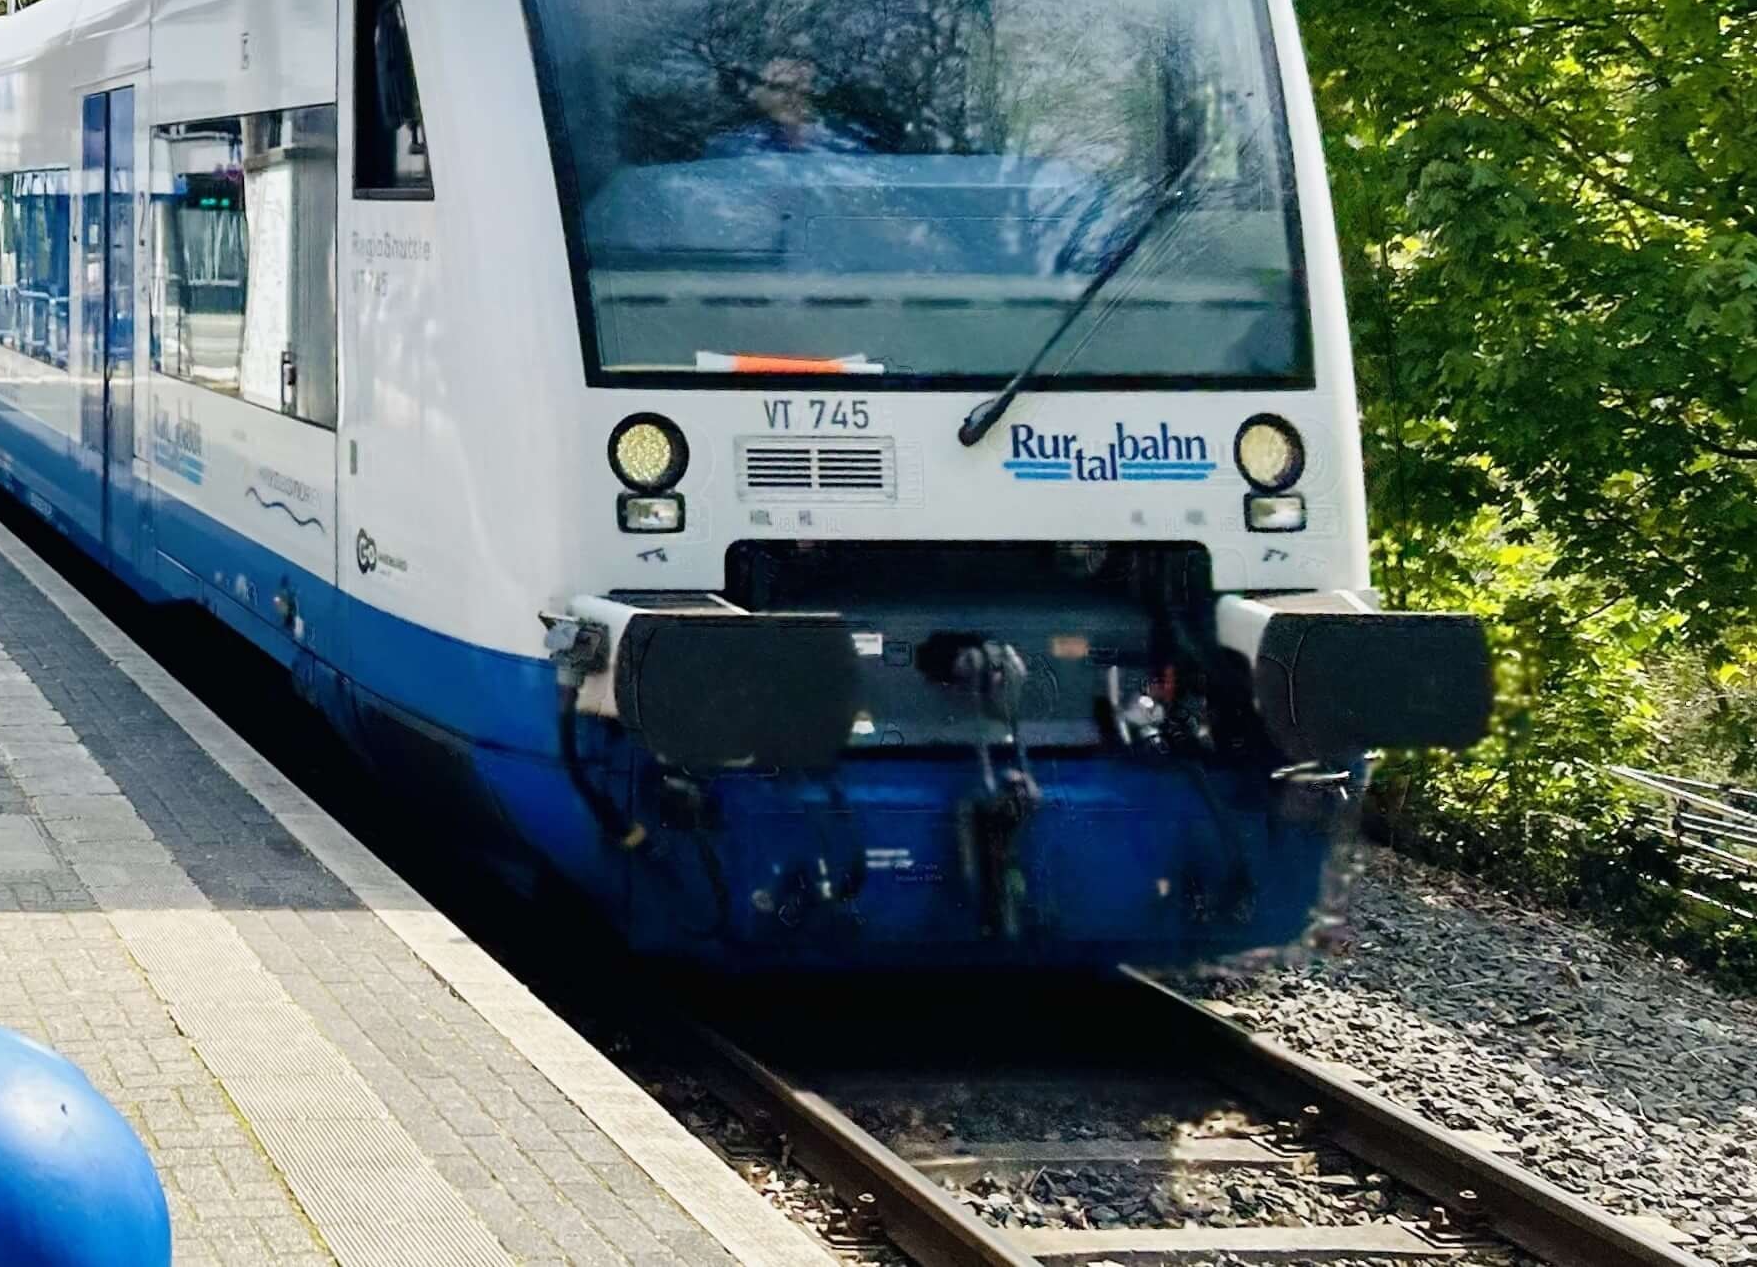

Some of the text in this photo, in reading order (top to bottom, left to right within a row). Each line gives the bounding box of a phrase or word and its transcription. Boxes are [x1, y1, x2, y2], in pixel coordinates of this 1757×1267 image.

[763, 399, 870, 429] VT 745
[1011, 422, 1207, 481] Rurtalbahn
